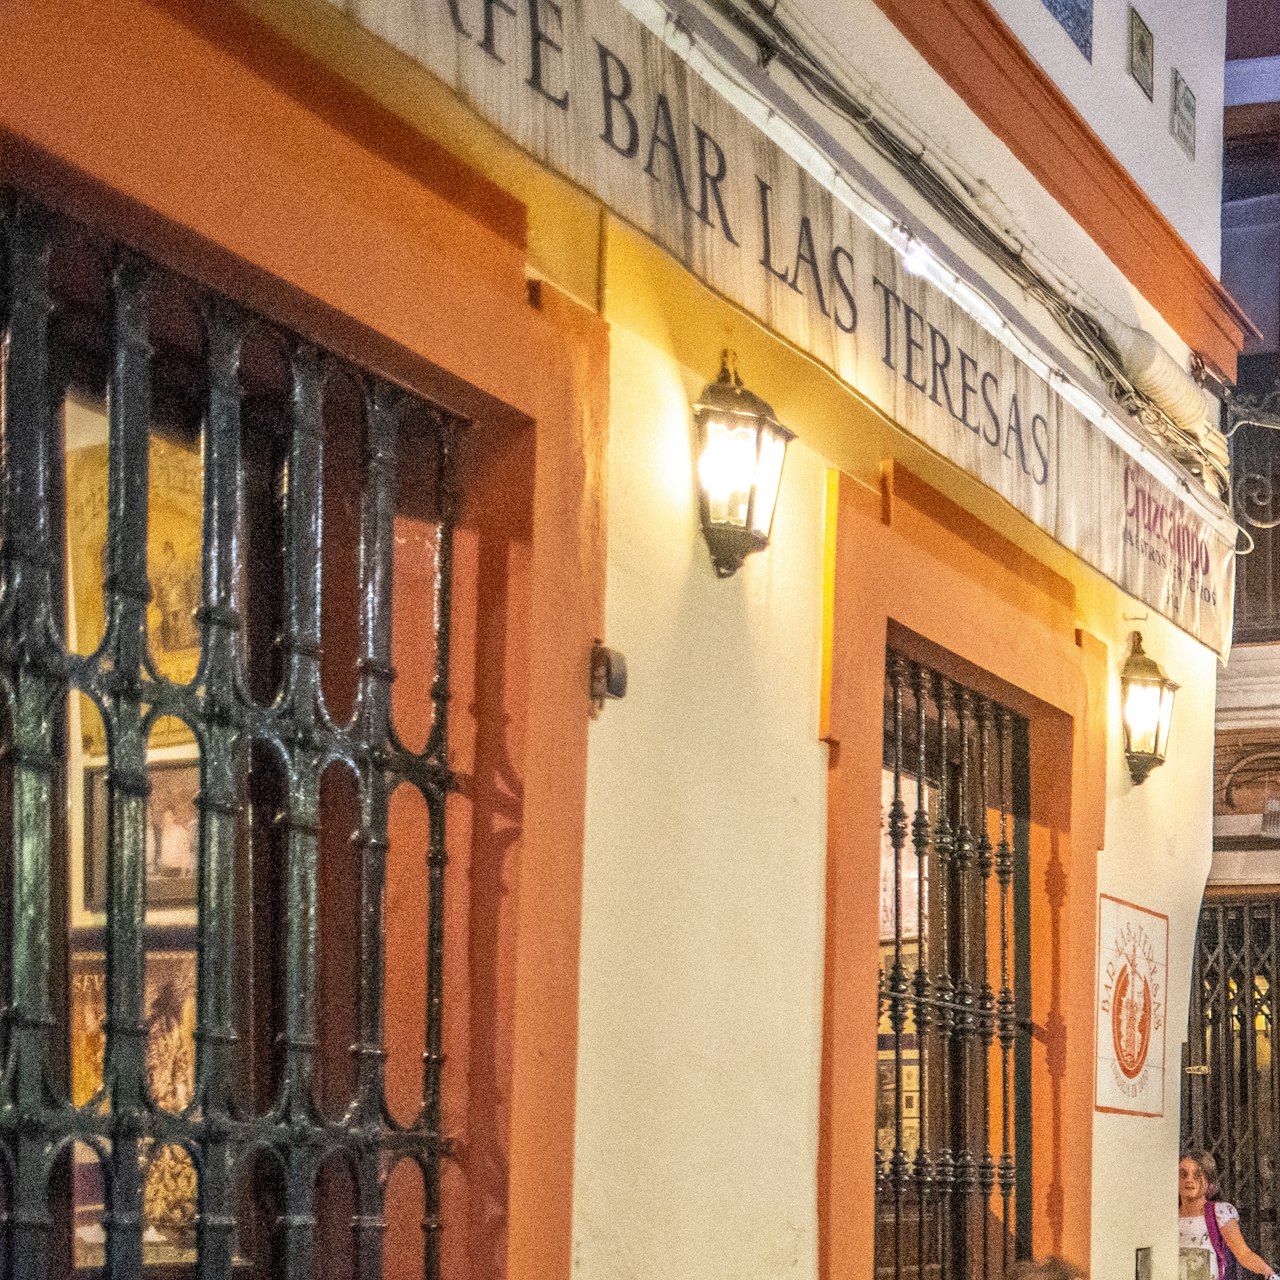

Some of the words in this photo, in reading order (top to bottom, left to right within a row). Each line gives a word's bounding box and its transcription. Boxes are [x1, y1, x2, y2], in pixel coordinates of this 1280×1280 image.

[592, 37, 740, 248] BAR
[754, 174, 858, 335] LAS
[872, 274, 1049, 486] TERESAS
